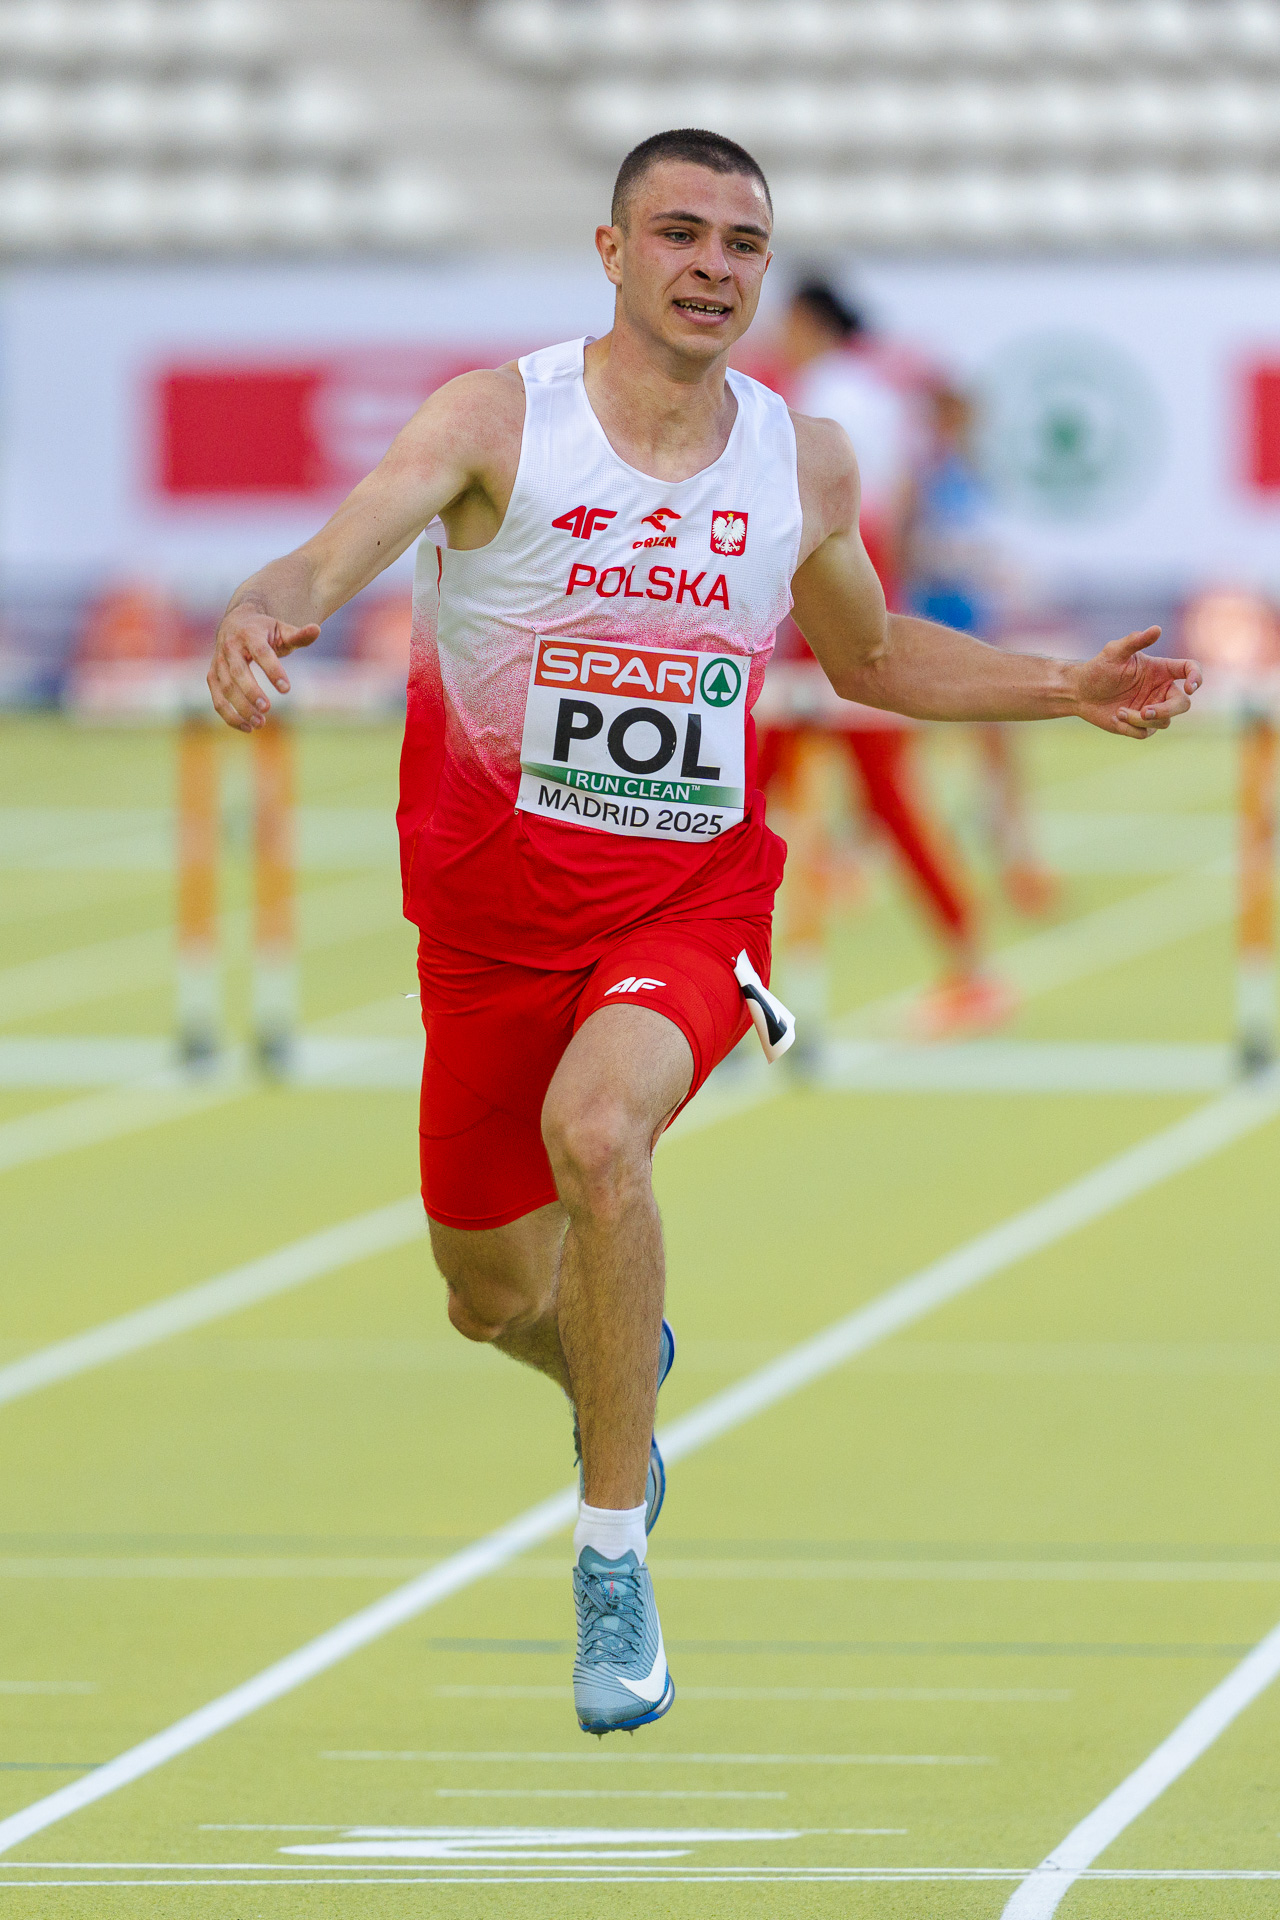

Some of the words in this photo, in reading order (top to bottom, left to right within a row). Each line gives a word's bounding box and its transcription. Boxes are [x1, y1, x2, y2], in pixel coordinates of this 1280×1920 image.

[551, 505, 618, 540] 4F
[632, 536, 677, 550] ORLEN
[565, 563, 730, 611] POLSKA
[540, 647, 691, 697] SPAR
[552, 698, 721, 781] POL
[566, 771, 572, 786] I
[575, 772, 621, 793] RUN
[538, 785, 650, 828] MADRID
[656, 810, 723, 836] 2025
